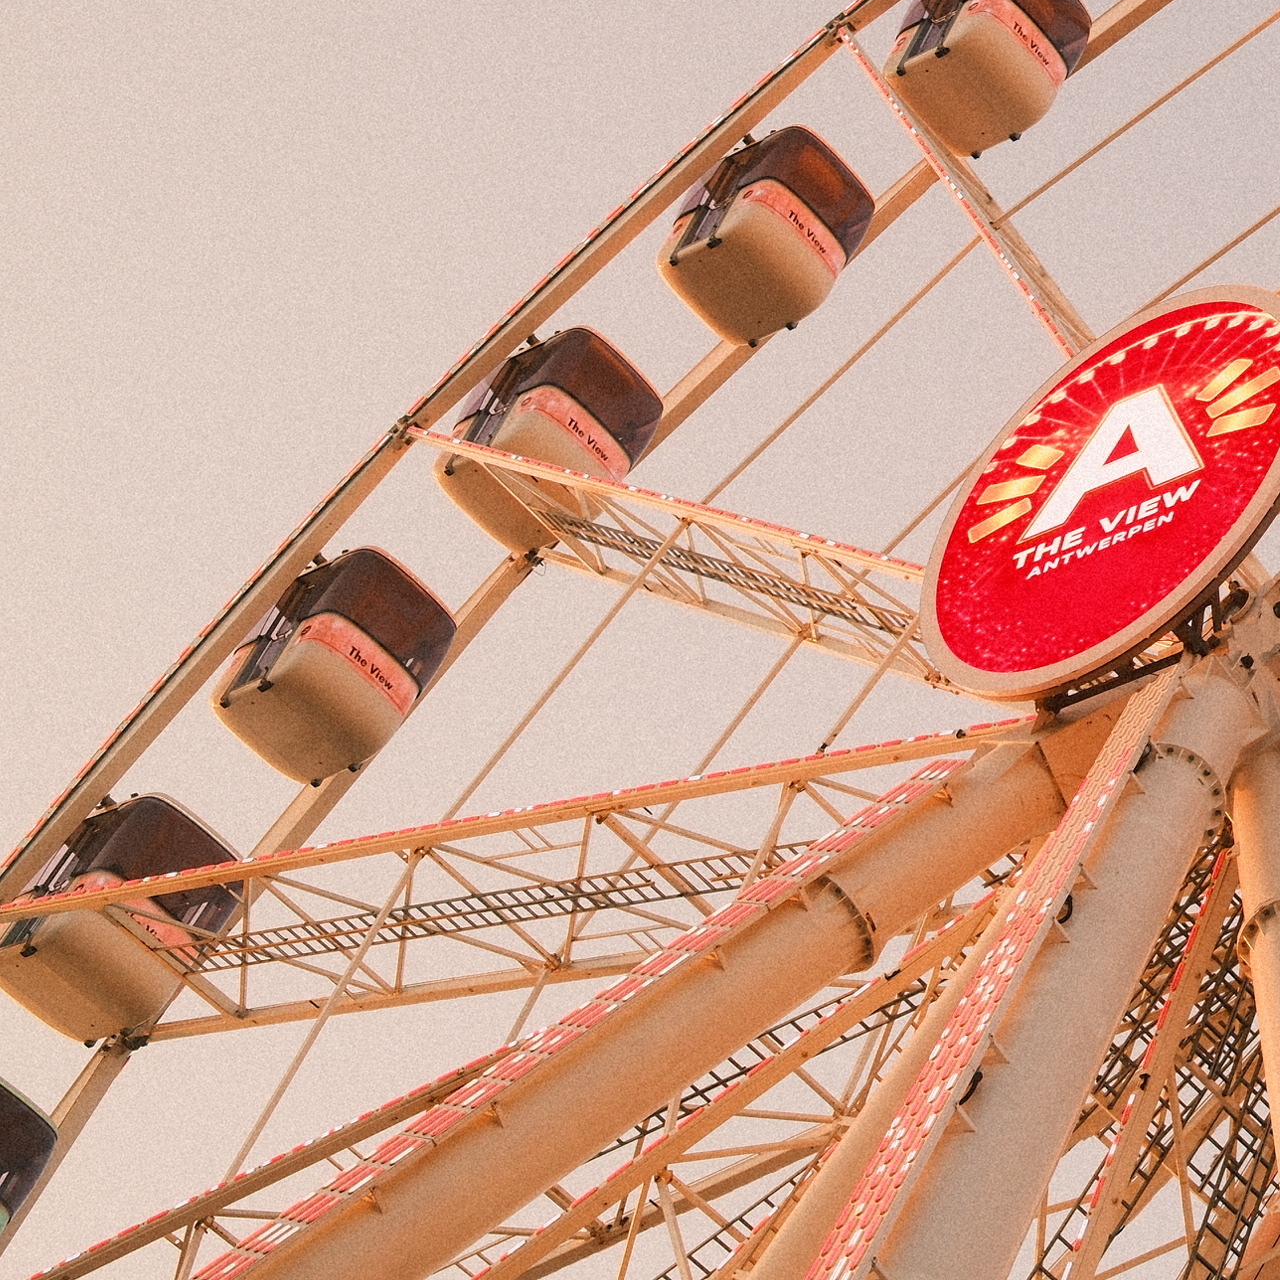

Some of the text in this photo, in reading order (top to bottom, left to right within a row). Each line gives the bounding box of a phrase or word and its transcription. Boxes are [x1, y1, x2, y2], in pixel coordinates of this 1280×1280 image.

[1013, 21, 1049, 65] The View
[788, 210, 826, 253] The View
[568, 417, 608, 461] The View
[1018, 384, 1204, 544] A
[1013, 479, 1201, 569] THE VIEW
[1026, 511, 1175, 580] ANTWERPEN
[349, 645, 393, 690] The View
